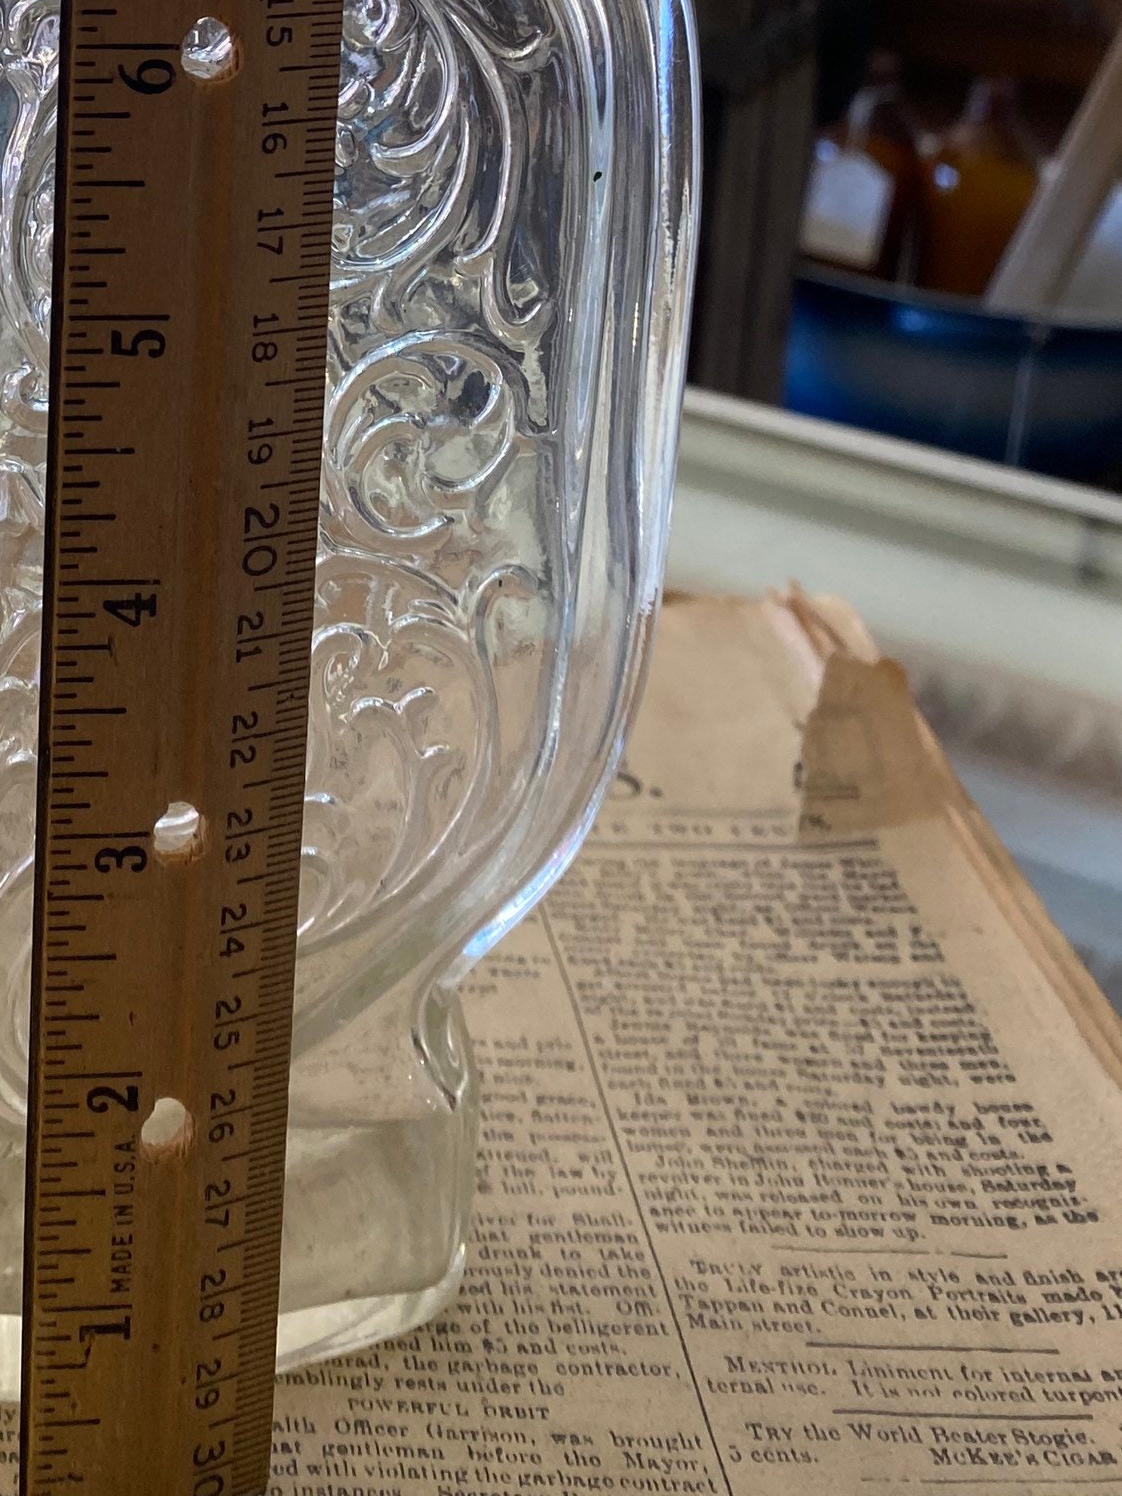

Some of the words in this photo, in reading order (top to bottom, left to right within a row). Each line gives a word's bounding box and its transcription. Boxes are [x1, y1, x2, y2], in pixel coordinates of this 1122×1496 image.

[117, 58, 175, 94] 6
[261, 102, 289, 155] 16
[257, 207, 285, 256] 17
[110, 329, 167, 359] 5
[251, 313, 279, 363] 18
[247, 416, 274, 465] 19
[241, 503, 279, 576] 20
[103, 593, 157, 628] 4
[235, 611, 264, 663] 21
[229, 711, 258, 769] 22
[225, 809, 253, 863] 23
[94, 846, 148, 874] 3
[219, 904, 247, 958] 24
[213, 996, 242, 1051] 25
[86, 1085, 139, 1114] 2
[208, 1089, 236, 1144] 26
[114, 1134, 137, 1195] U.S.A.
[113, 1206, 134, 1226] IN
[204, 1179, 232, 1228] 27
[834, 1224, 886, 1240] show
[111, 1234, 133, 1293] MADE
[870, 1265, 893, 1282] in
[975, 1270, 1016, 1287] and
[199, 1270, 227, 1323] 28
[678, 1293, 765, 1315] Tappan
[772, 1299, 813, 1316] and
[913, 1305, 938, 1321] at
[1008, 1306, 1096, 1327] gallery,
[832, 1284, 913, 1304] Crayon
[928, 1283, 1028, 1306] Portraits
[1041, 1287, 1104, 1304] made
[79, 1316, 131, 1341] 1
[470, 1319, 492, 1336] of
[504, 1319, 540, 1335] the
[547, 1317, 670, 1337] belligerent
[684, 1312, 744, 1332] Main
[751, 1318, 822, 1334] street.
[431, 1336, 473, 1354] him
[516, 1339, 557, 1356] and
[195, 1359, 222, 1410] 29
[403, 1357, 438, 1373] the
[447, 1358, 540, 1378] garbage
[555, 1359, 681, 1380] contractor,
[959, 1365, 994, 1383] for
[457, 1379, 521, 1396] under
[529, 1380, 565, 1397] the
[550, 1432, 594, 1446] was
[609, 1430, 703, 1452] brought
[745, 1422, 795, 1443] TRY
[803, 1422, 841, 1442] the
[192, 1442, 225, 1496] 30
[321, 1442, 446, 1463] gentleman
[467, 1444, 542, 1465] before
[563, 1451, 602, 1469] the
[623, 1451, 710, 1475] Mayor,
[750, 1448, 820, 1465] cents.
[1042, 1449, 1119, 1468] CIGAR
[306, 1459, 357, 1478] with
[364, 1461, 469, 1485] violating
[474, 1465, 511, 1484] the
[517, 1467, 616, 1489] garbage
